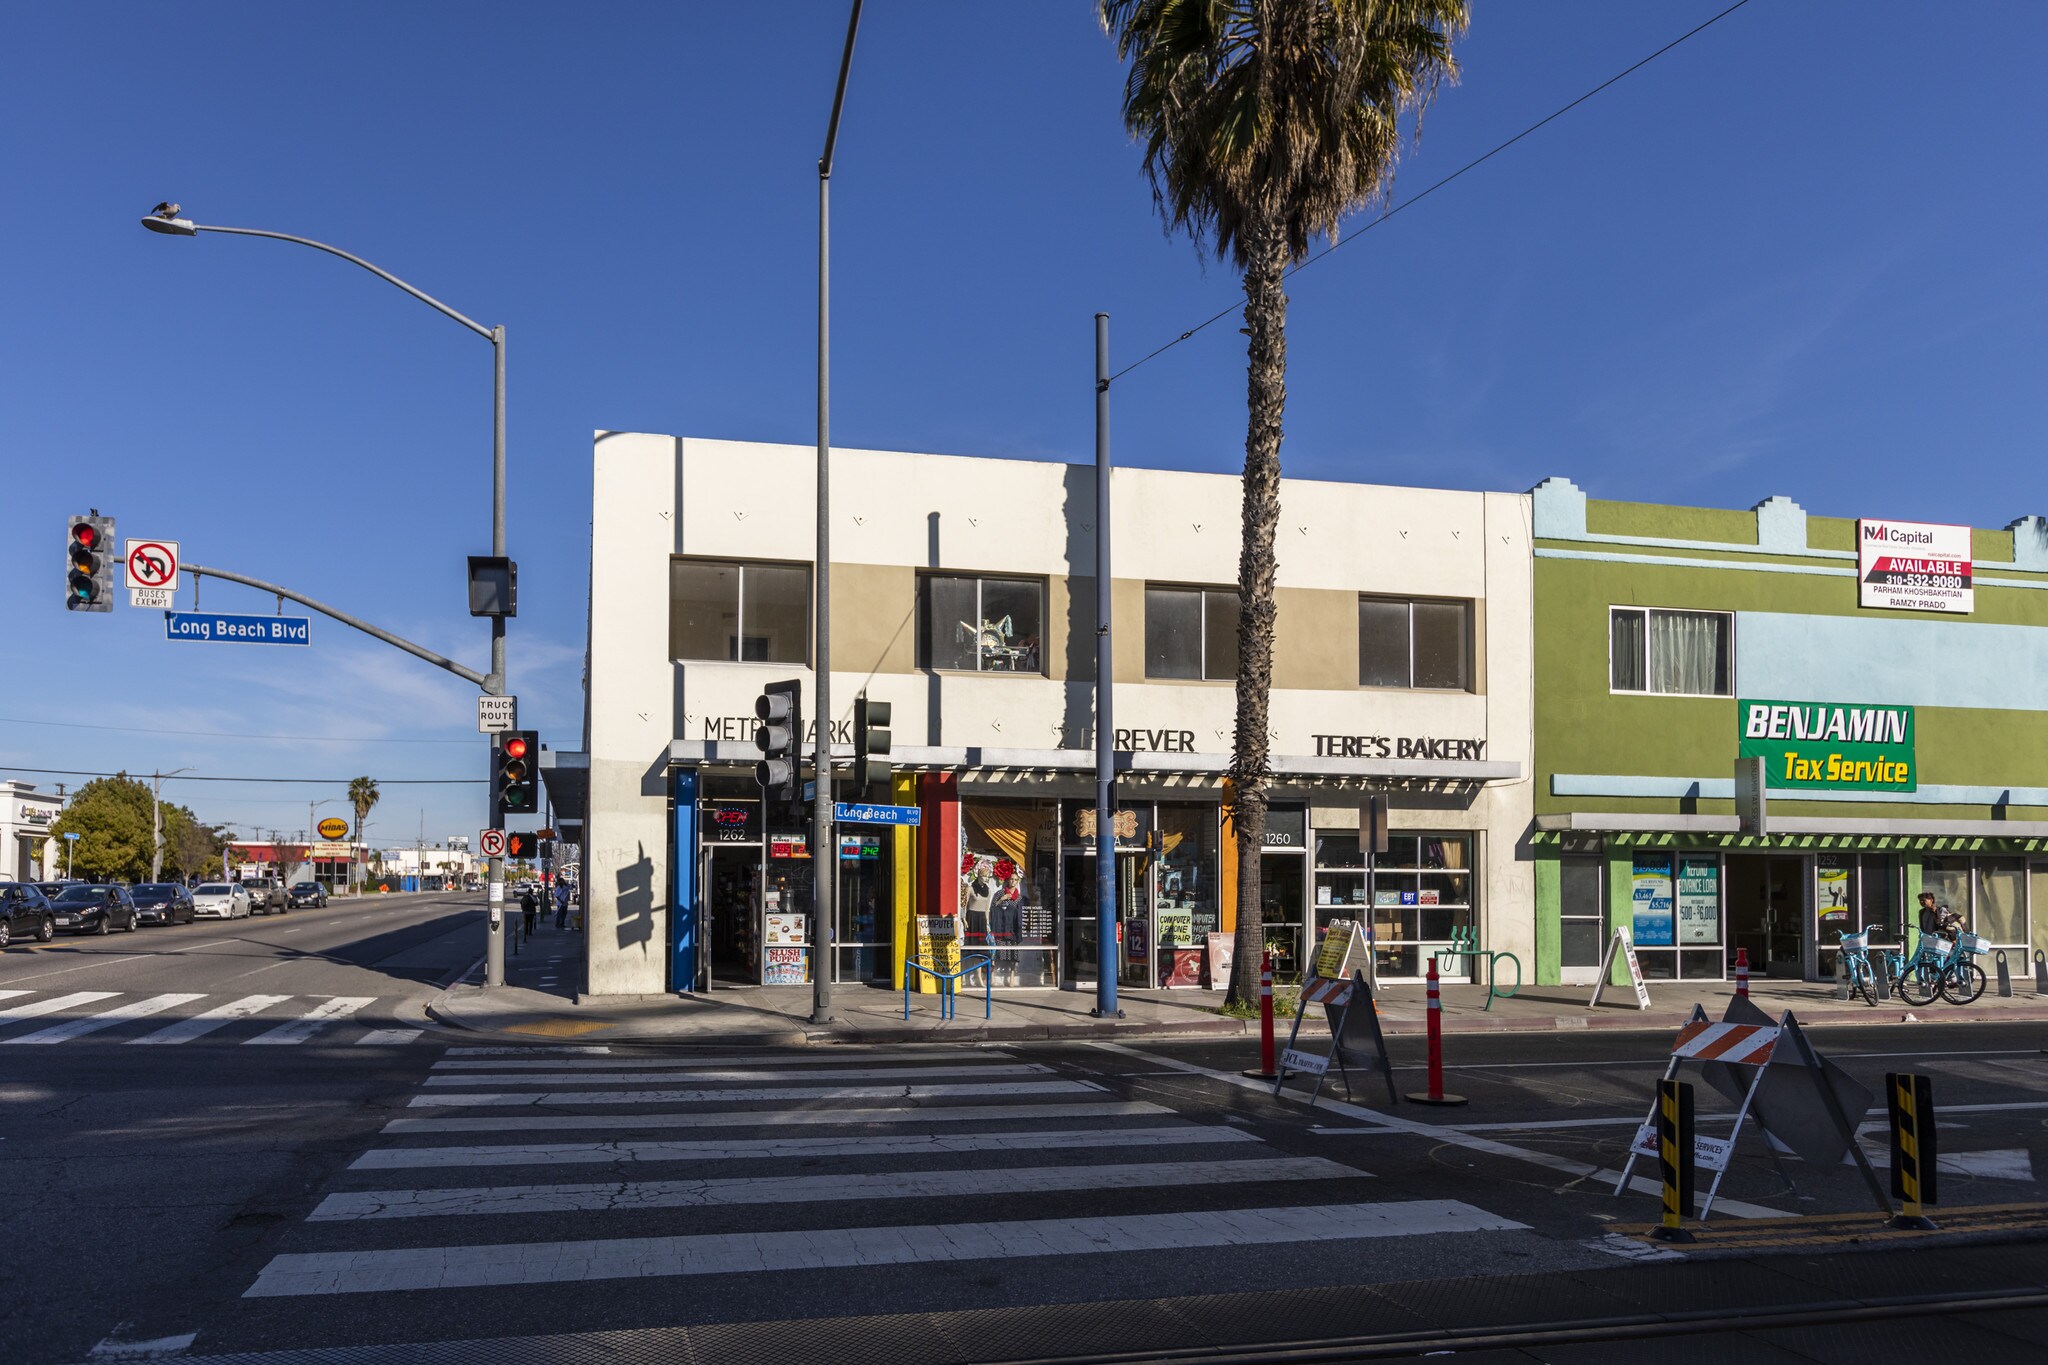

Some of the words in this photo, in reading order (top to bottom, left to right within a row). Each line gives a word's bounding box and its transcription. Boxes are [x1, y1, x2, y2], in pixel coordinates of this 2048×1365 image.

[1864, 523, 1888, 540] NAI
[1890, 529, 1933, 545] Capital
[1889, 558, 1962, 575] AVAILABLE
[1886, 574, 1962, 589] 310-532-9080
[138, 588, 166, 599] BUSES
[1873, 585, 1903, 596] PARHAM
[1904, 587, 1963, 598] KHOSHBAKHTIAN
[135, 598, 168, 607] EXEMPT
[1890, 598, 1917, 607] RAMZY
[1919, 600, 1946, 609] PRADO
[169, 619, 210, 640] Long
[216, 620, 266, 638] Beach
[272, 622, 307, 639] Blvd
[480, 701, 515, 709] TRUCK
[480, 712, 515, 720] ROUTE
[705, 716, 764, 741] METR
[1746, 704, 1908, 744] BENJAMIN
[1311, 734, 1391, 759] TERE'S
[1397, 736, 1487, 761] BAKERY
[1784, 751, 1825, 781] Tax
[1826, 753, 1908, 783] Service
[837, 806, 861, 820] Long
[867, 807, 897, 820] Beach
[320, 822, 346, 832] MIDAS
[719, 829, 746, 841] 1262
[1265, 833, 1291, 845] 1260
[862, 846, 879, 856] 342
[1818, 855, 1837, 866] 1252
[1404, 892, 1415, 901] EBT
[921, 919, 955, 929] COMPUTER
[1160, 915, 1191, 924] COMPUTER
[1164, 925, 1188, 933] PHONE
[1162, 934, 1191, 942] REPAIR
[769, 948, 801, 956] SLUSH
[1696, 1142, 1724, 1154] SERVICES
